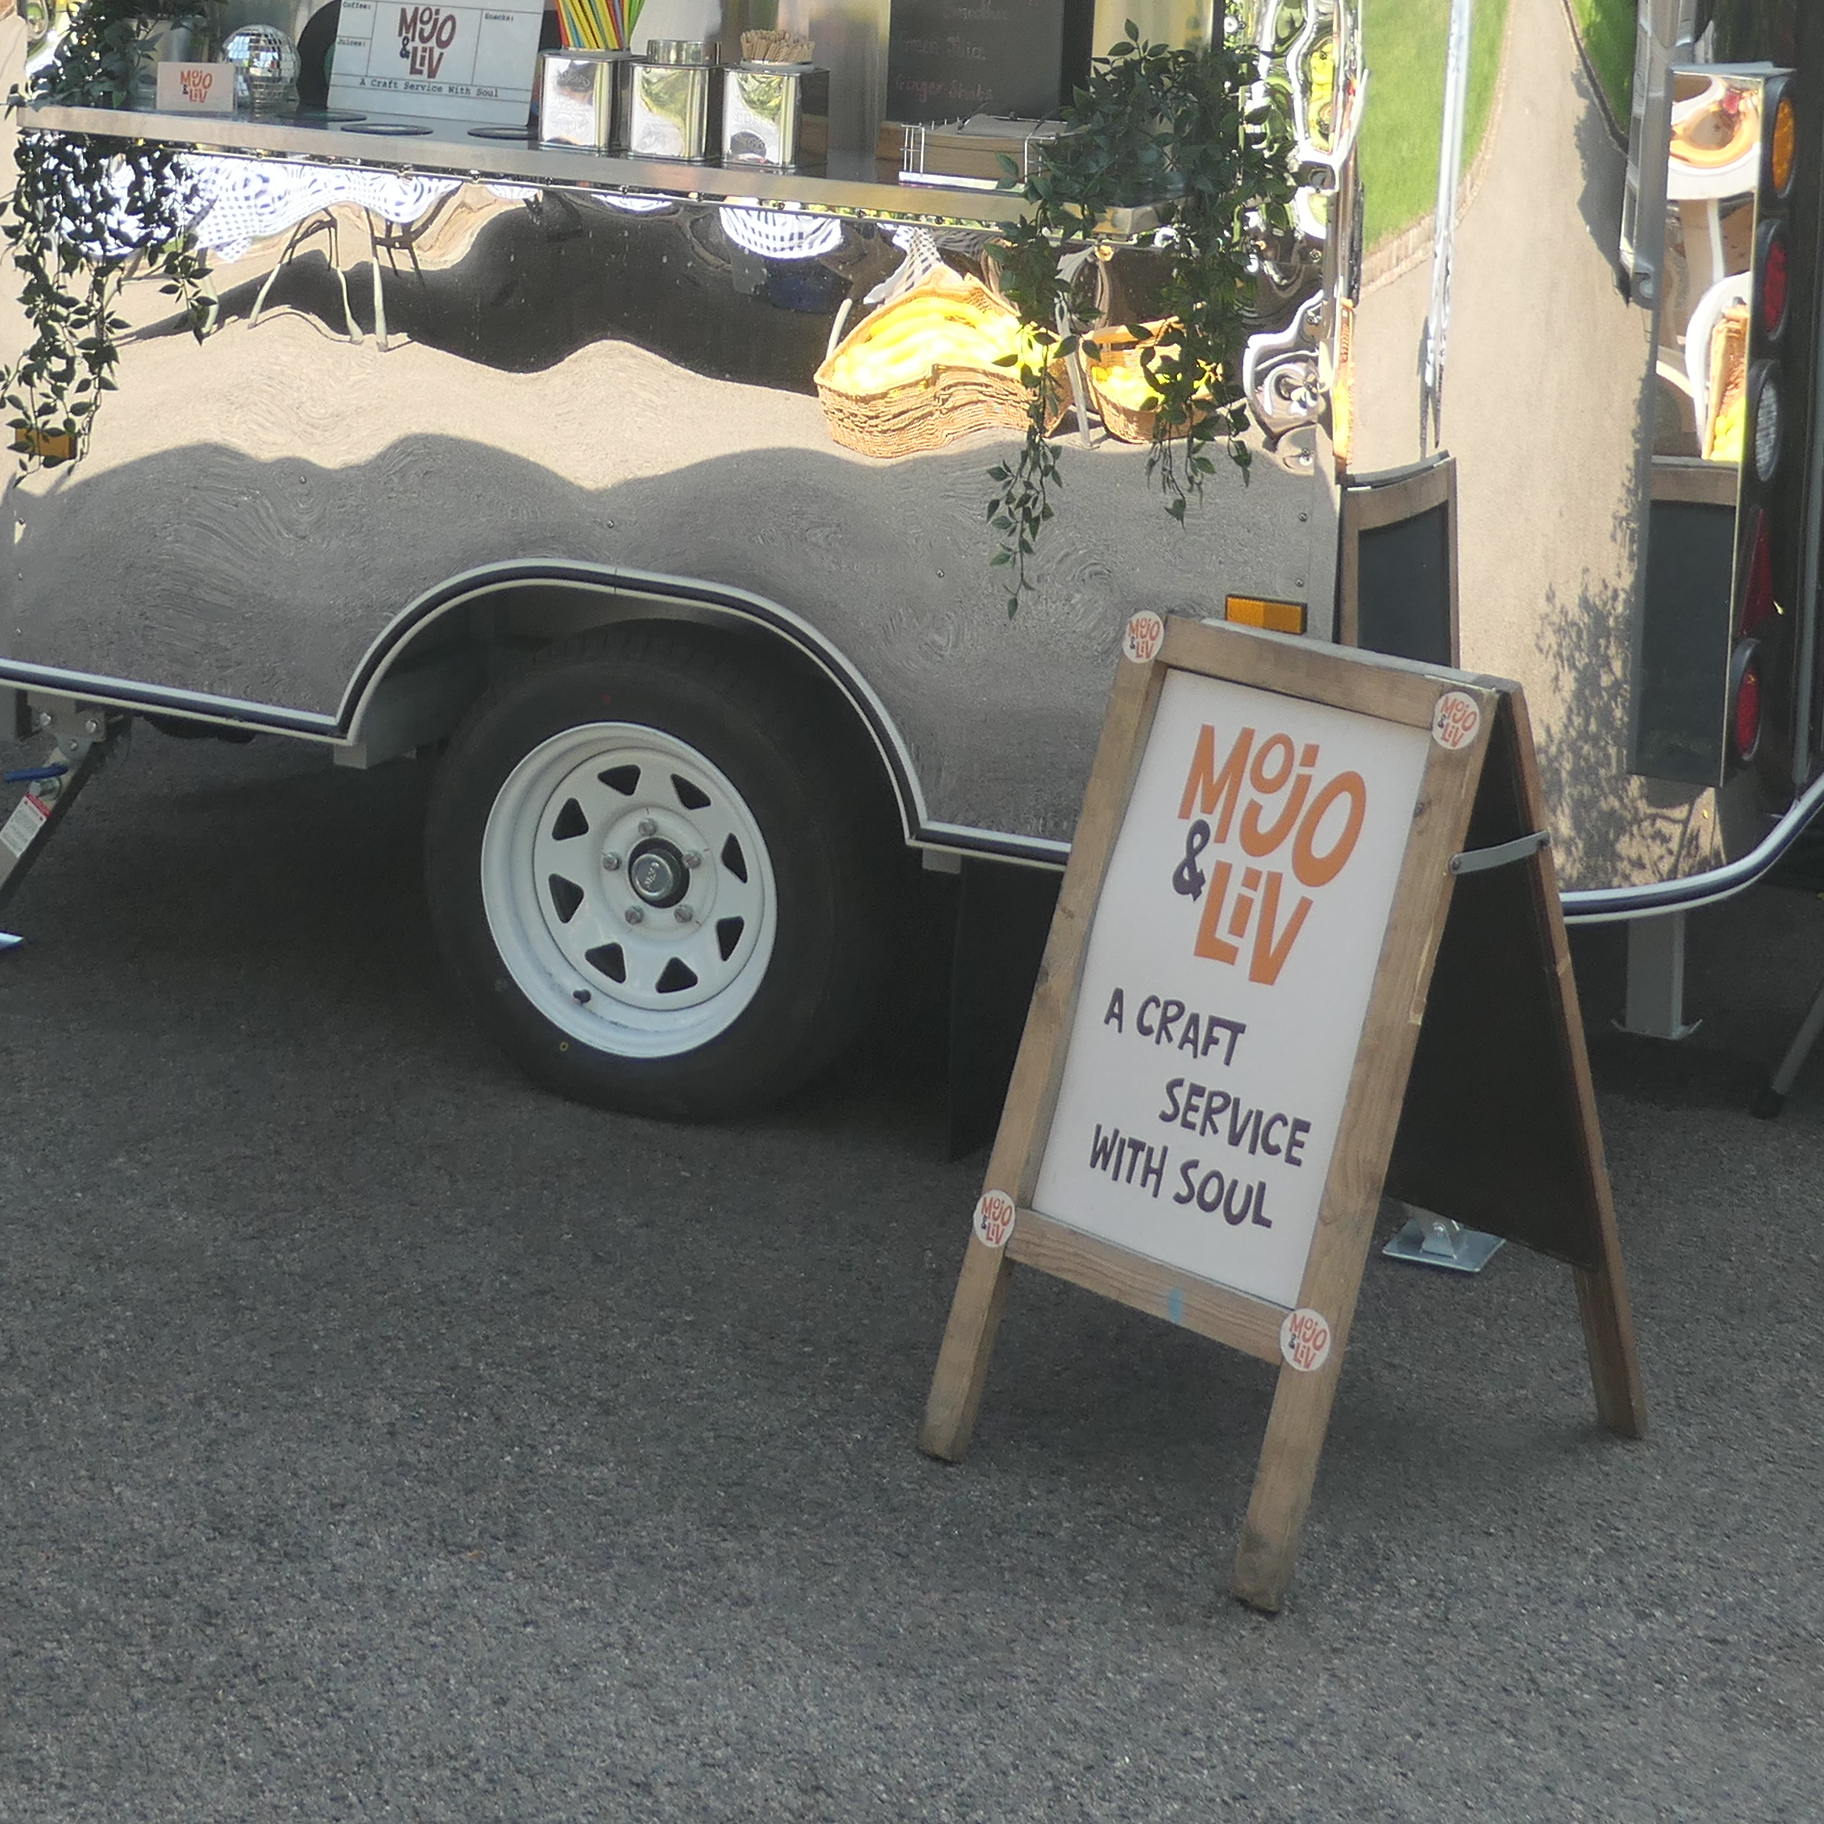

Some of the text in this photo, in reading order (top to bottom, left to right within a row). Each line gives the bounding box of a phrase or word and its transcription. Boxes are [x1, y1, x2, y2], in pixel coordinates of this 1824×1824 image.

[359, 78, 499, 98] A Craft Service With Soul
[399, 35, 411, 59] &
[1172, 819, 1211, 904] &
[1103, 987, 1247, 1067] A CRAFT
[1158, 1077, 1312, 1167] SERVICE
[1089, 1123, 1273, 1230] WITH SOUL
